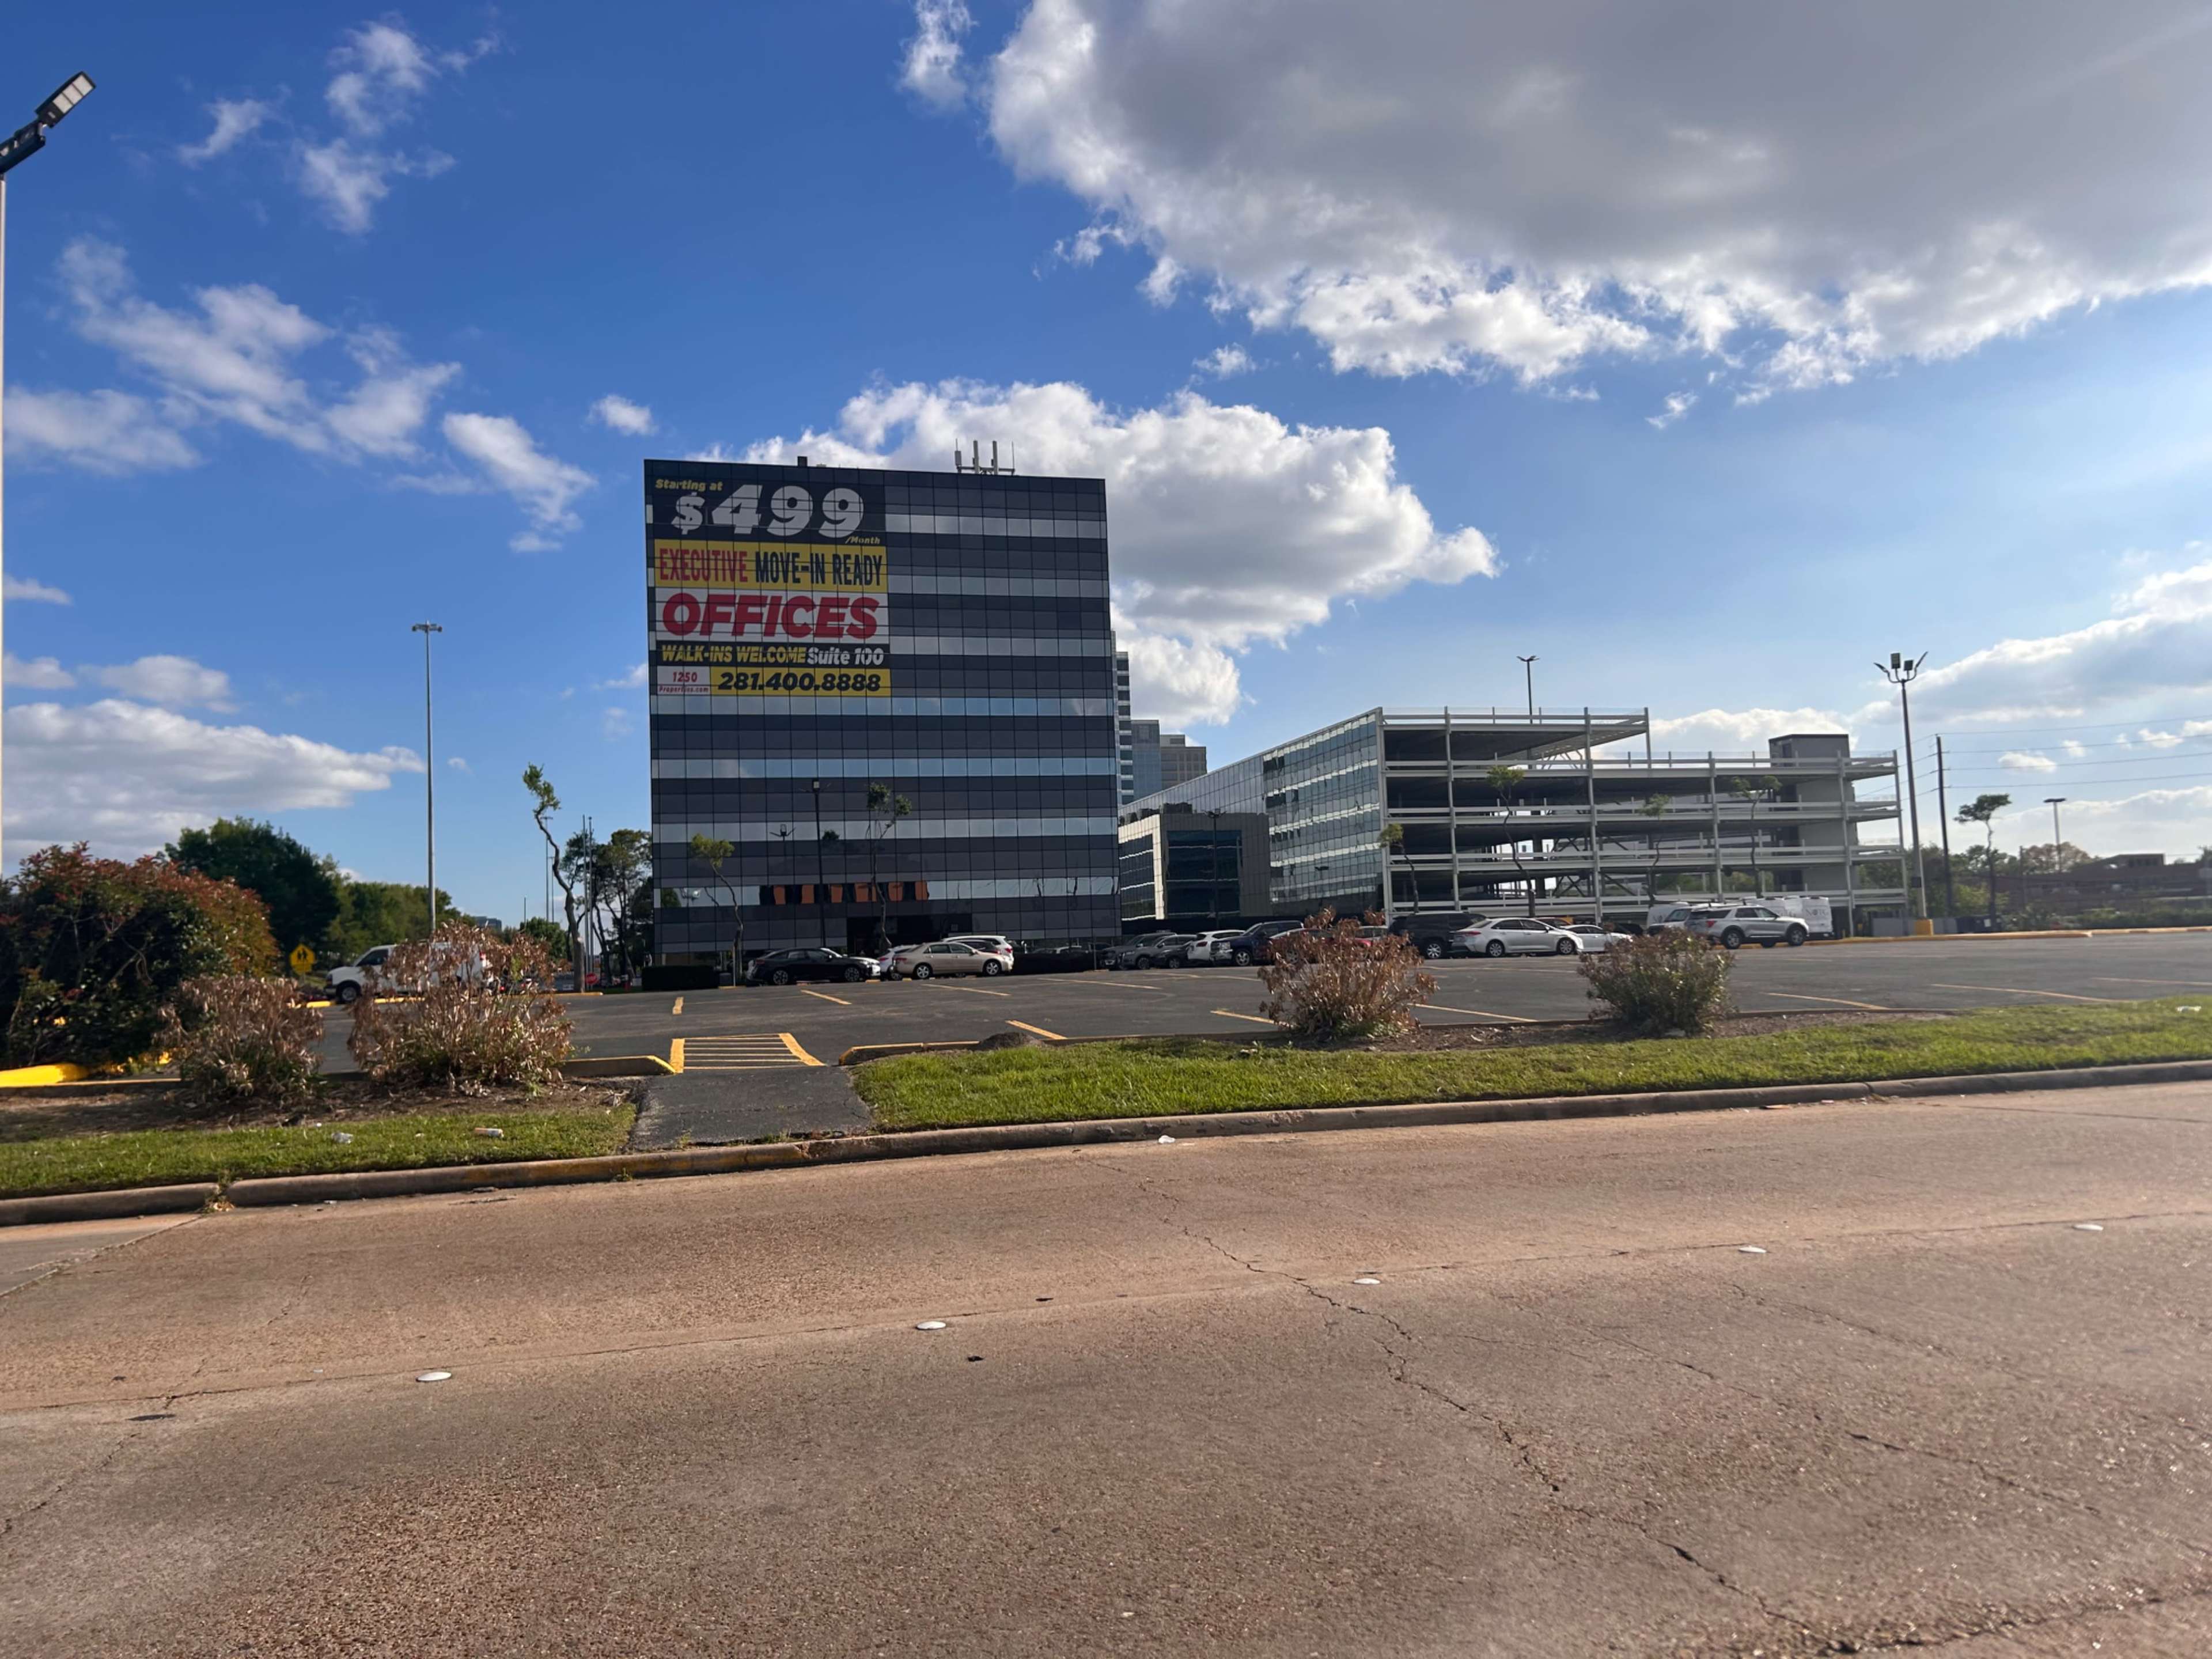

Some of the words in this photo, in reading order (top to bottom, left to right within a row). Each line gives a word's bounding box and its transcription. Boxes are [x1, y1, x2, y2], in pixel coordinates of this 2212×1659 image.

[656, 479, 706, 491] Starting
[709, 482, 723, 491] at
[671, 484, 863, 538] $499
[659, 548, 748, 582] EXECUTIVE
[755, 551, 825, 585] MOVE-IN
[832, 554, 882, 586] READY
[663, 593, 880, 639] OFFICES
[662, 645, 733, 662] WALK-INS
[736, 646, 806, 663] WELCOME
[807, 647, 850, 665] Suite
[855, 647, 884, 665] 100
[672, 671, 698, 683] 1250
[718, 672, 881, 692] 281.400.8888
